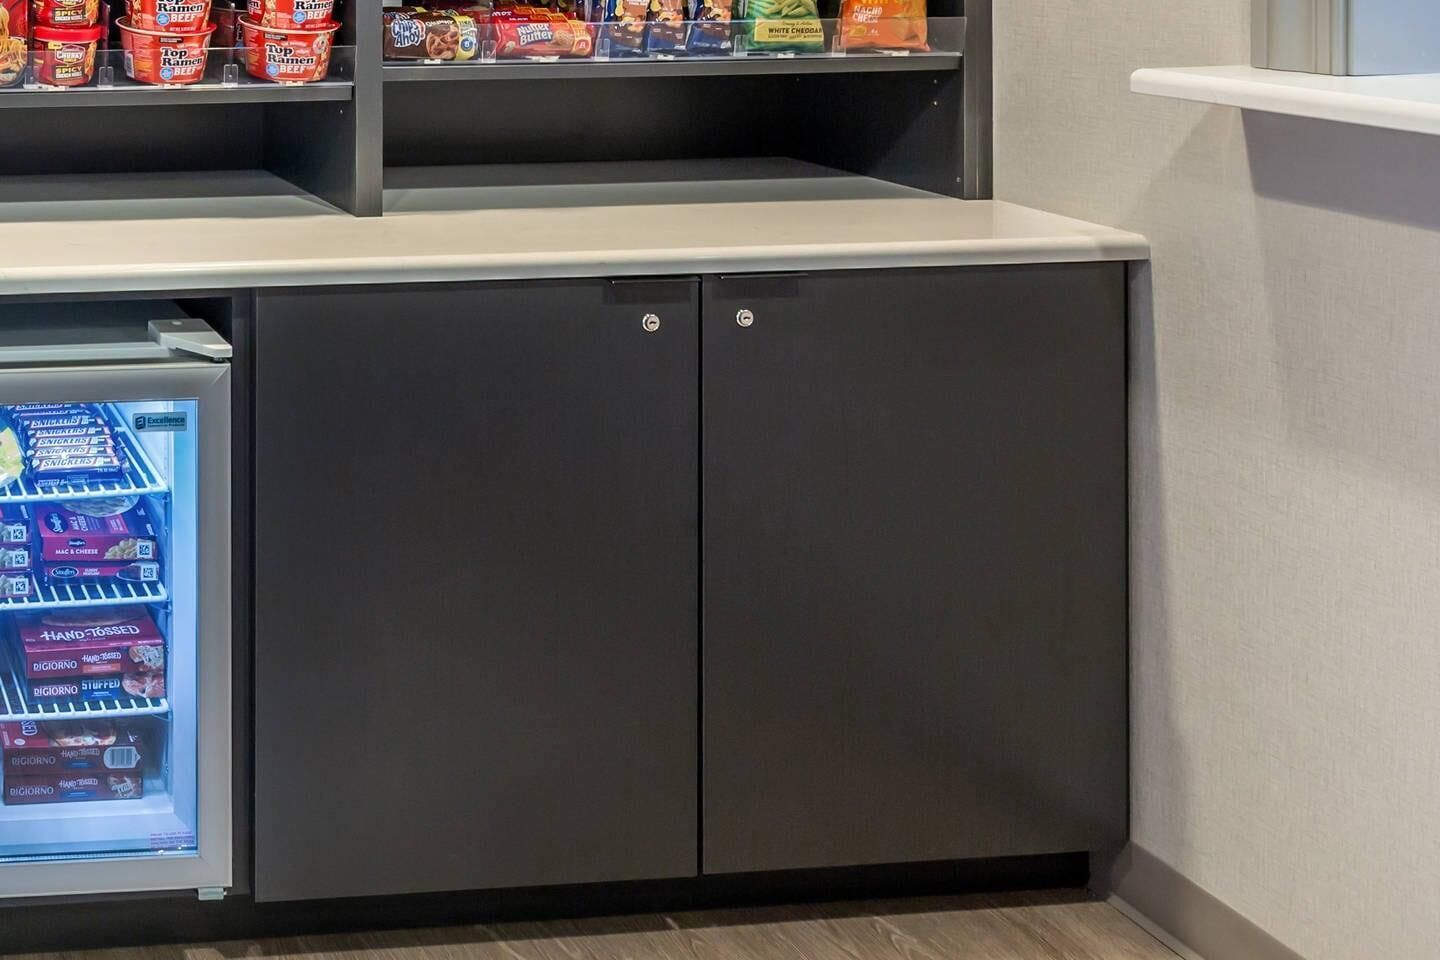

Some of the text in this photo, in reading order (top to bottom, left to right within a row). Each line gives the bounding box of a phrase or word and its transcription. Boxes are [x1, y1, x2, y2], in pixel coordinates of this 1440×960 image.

[157, 2, 203, 12] Ramen
[295, 0, 332, 10] Ramen
[170, 13, 197, 23] BEEF
[307, 10, 328, 20] BEEF
[517, 23, 549, 36] Nutter
[520, 31, 553, 46] Butter
[162, 47, 187, 59] Top
[266, 44, 293, 57] Top
[162, 57, 202, 67] Ramen
[267, 55, 314, 65] Ramen
[174, 66, 196, 75] BEEF
[280, 64, 306, 73] BEEF
[32, 418, 79, 427] SNICKERS
[147, 417, 185, 425] Excellence
[38, 428, 86, 436] SNICKERS
[39, 447, 86, 456] SNICKERS
[43, 458, 93, 468] SNICKERS
[40, 625, 140, 641] HAND-TOSSED
[81, 679, 120, 690] STUFFED
